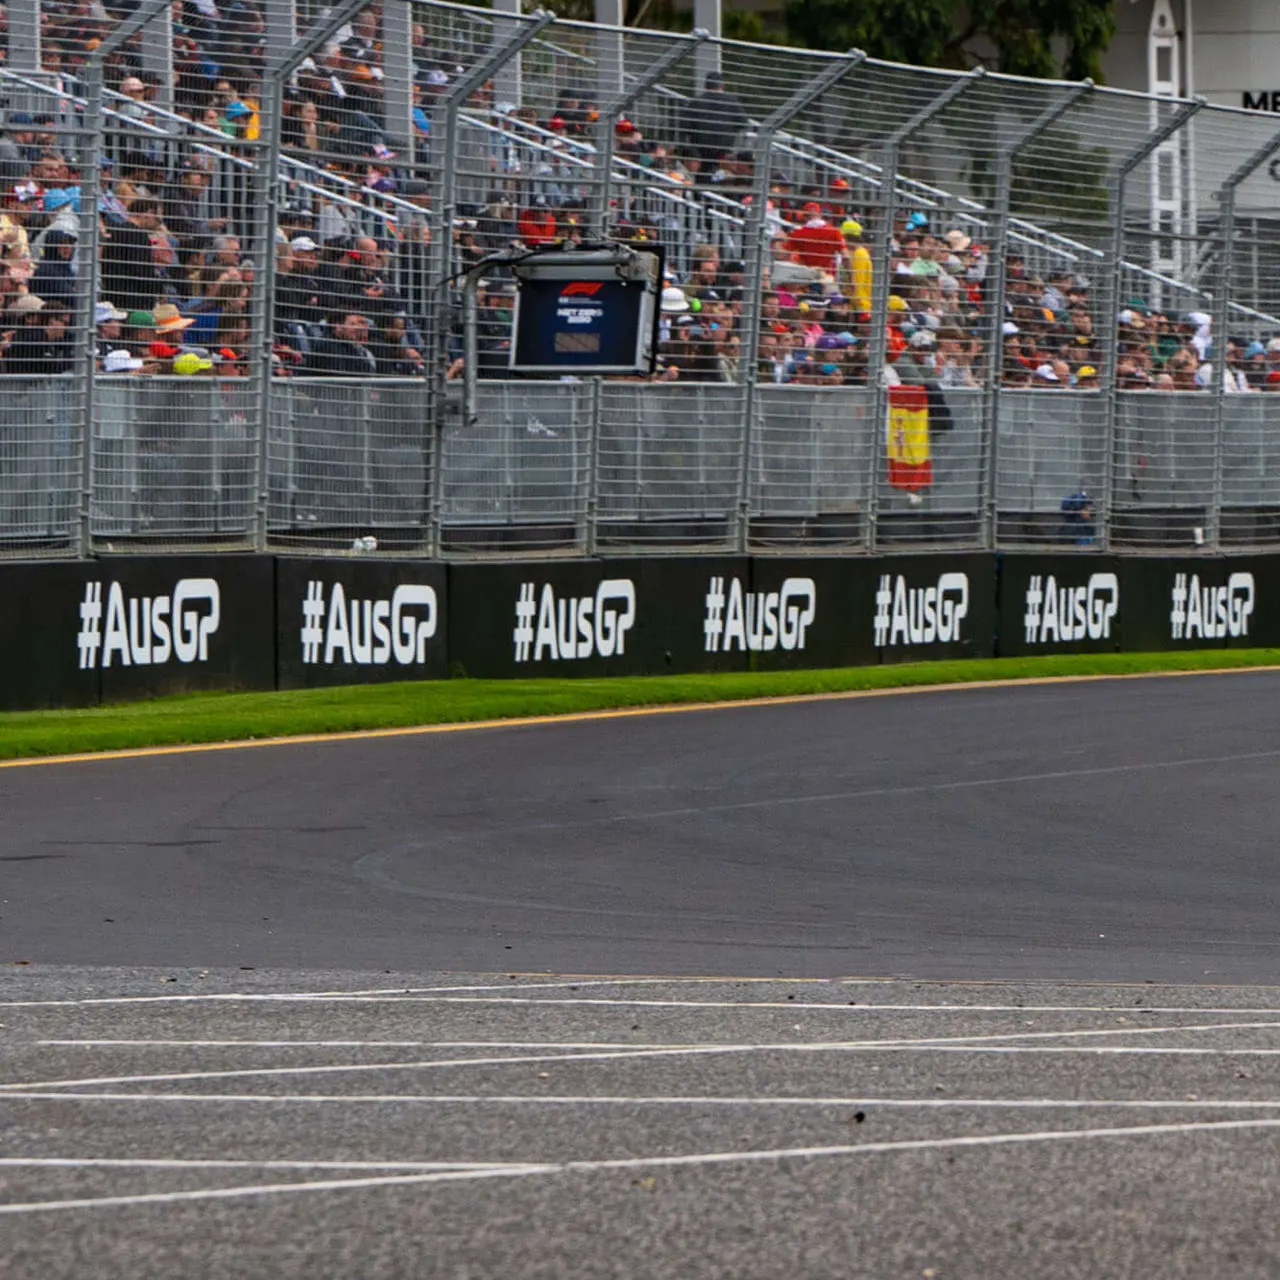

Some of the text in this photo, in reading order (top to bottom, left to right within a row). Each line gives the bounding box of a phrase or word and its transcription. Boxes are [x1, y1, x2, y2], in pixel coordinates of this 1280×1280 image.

[78, 578, 220, 669] #AusGP
[302, 580, 437, 665] #AusGP
[514, 579, 636, 662] #AusGP
[704, 576, 816, 652] #AusGP
[874, 572, 969, 647] #AusGP
[1025, 573, 1119, 643] #AusGP
[1171, 572, 1255, 639] #AusGP
